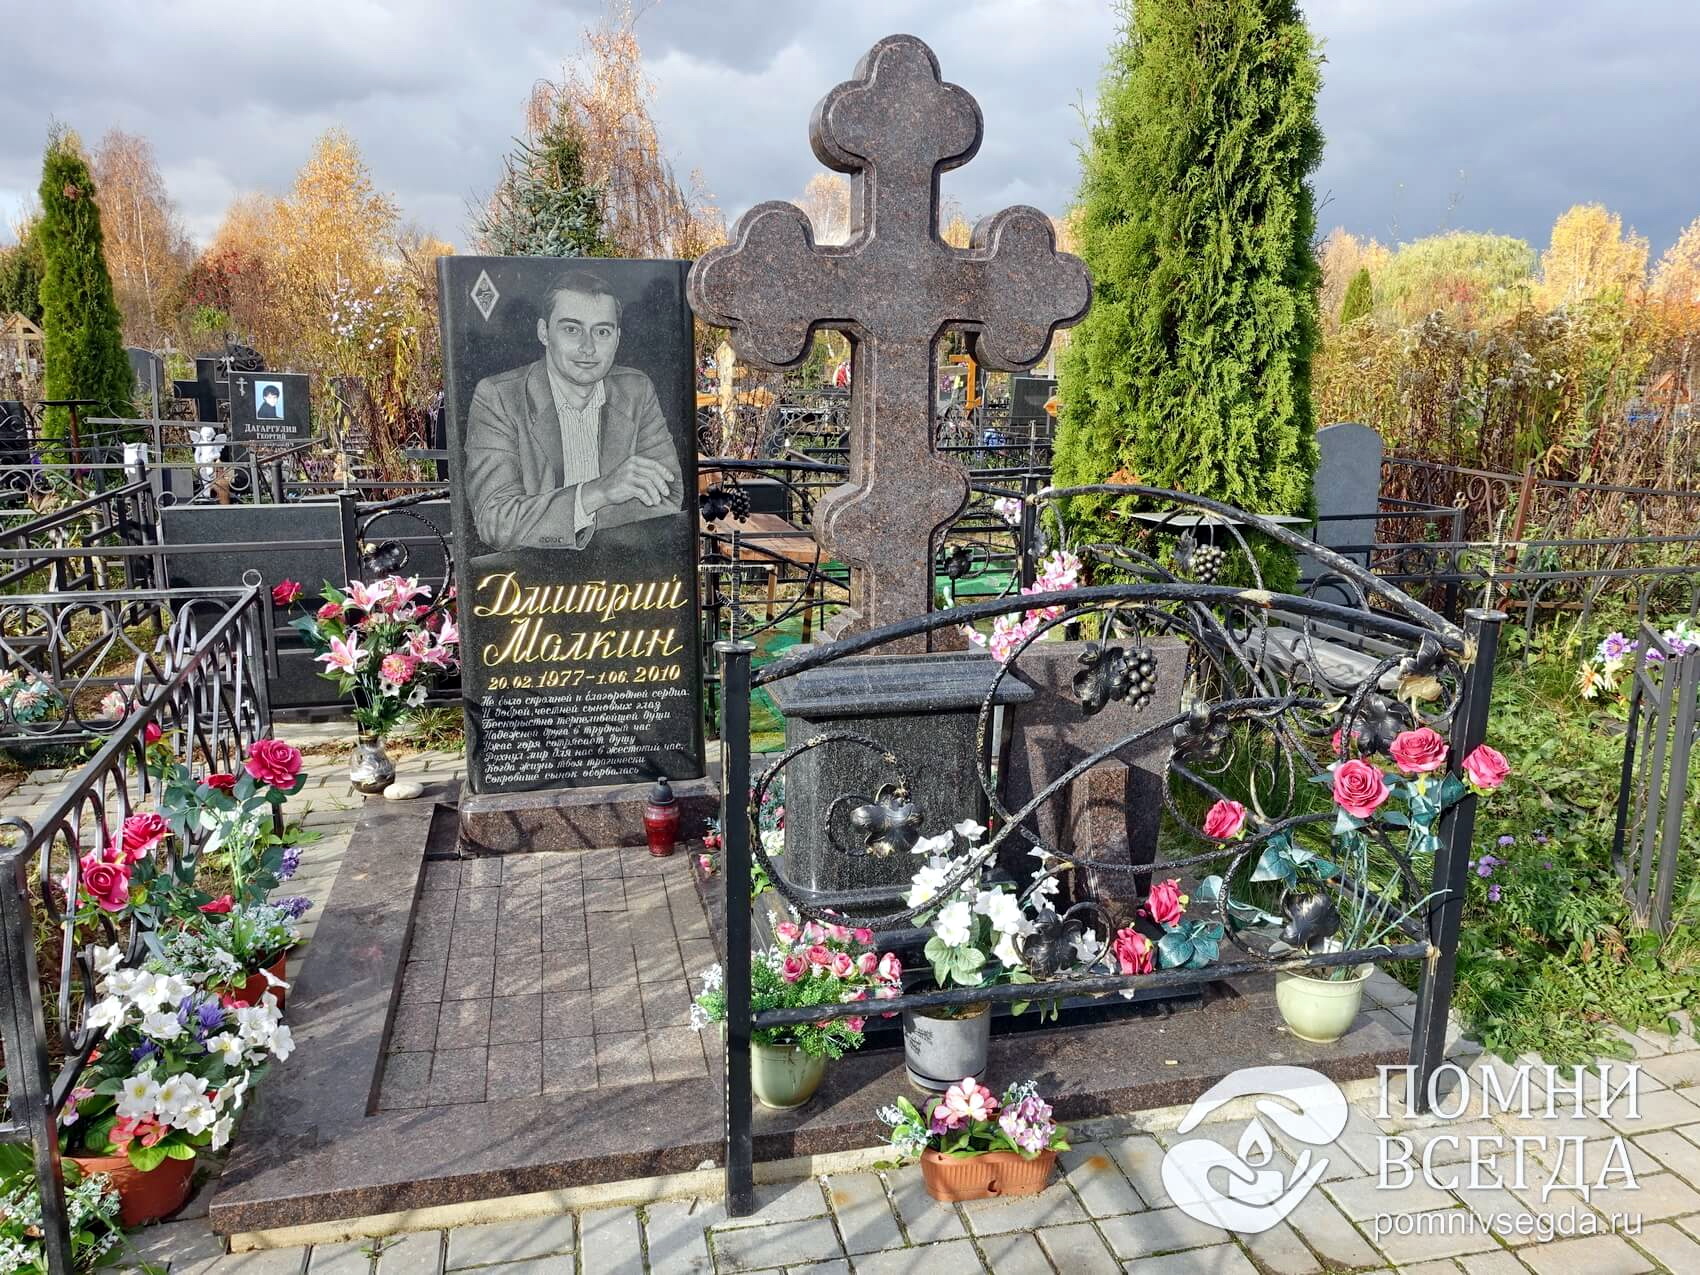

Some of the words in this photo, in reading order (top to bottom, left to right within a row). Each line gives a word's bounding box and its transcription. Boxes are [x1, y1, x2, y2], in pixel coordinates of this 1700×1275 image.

[256, 432, 286, 440] ГЕОРГИЙ
[473, 571, 688, 622] Дмитрий
[483, 617, 684, 666] Малкин
[480, 696, 494, 706] Не
[498, 696, 522, 706] было
[525, 694, 572, 706] скромней
[585, 689, 648, 702] благородней
[482, 708, 490, 718] И
[636, 701, 661, 712] глаз
[643, 710, 671, 722] души
[543, 727, 568, 739] друга
[573, 725, 580, 734] в
[584, 724, 628, 737] трудный
[483, 741, 512, 752] Ужас
[517, 740, 540, 752] горя
[608, 734, 636, 746] душу
[484, 752, 523, 764] Рухнул
[527, 751, 548, 761] мир
[552, 748, 571, 757] для
[598, 745, 604, 755] в
[606, 744, 660, 754] жестокий
[484, 762, 515, 773] Когда
[520, 762, 554, 773] жизнь
[557, 759, 583, 768] твоя
